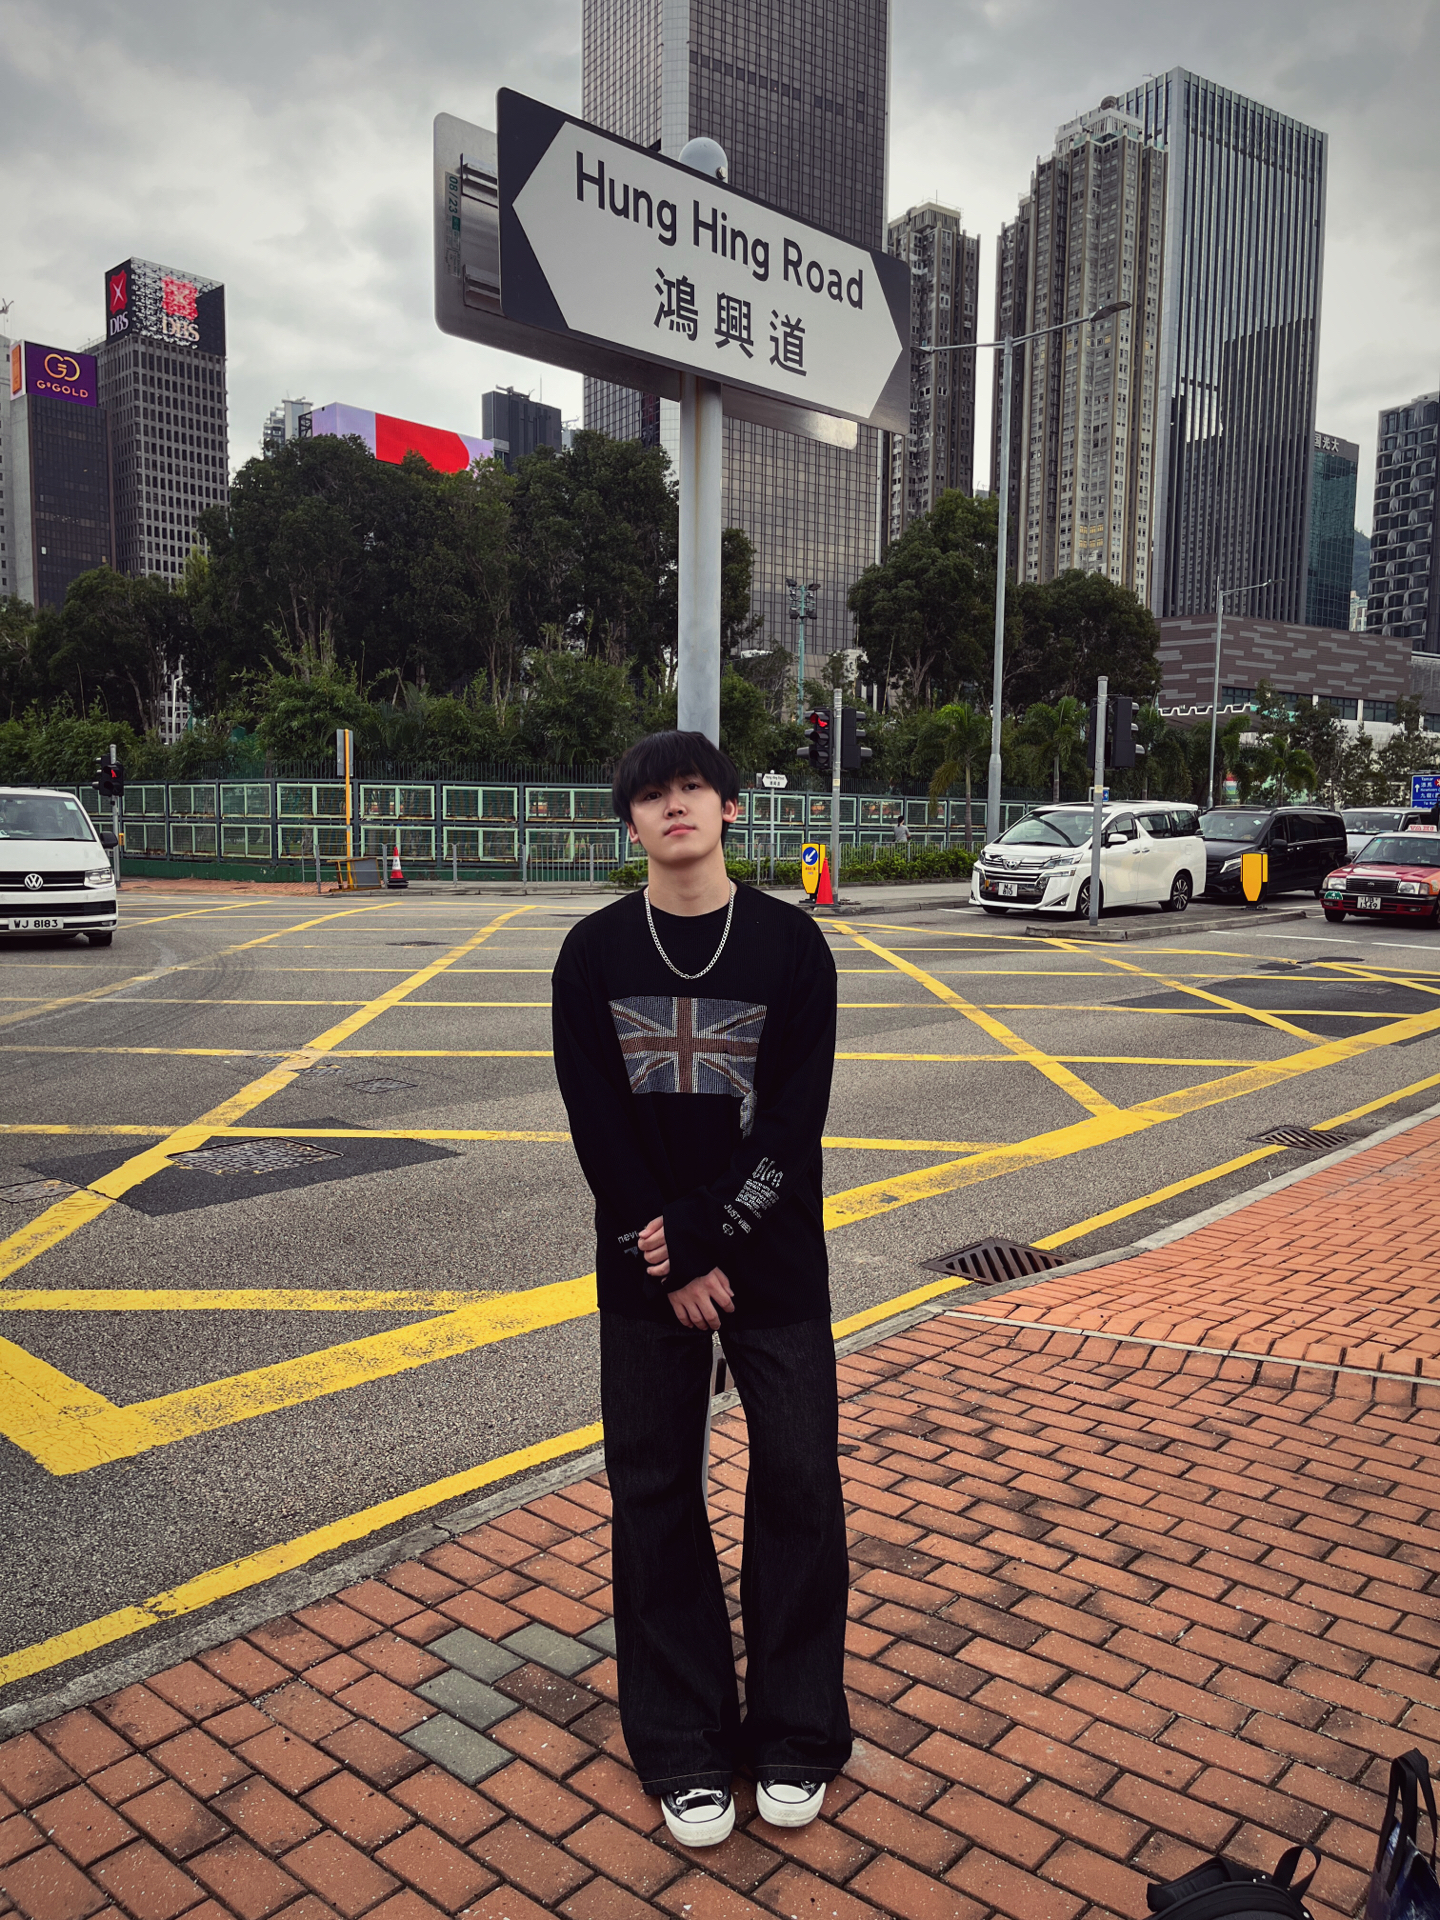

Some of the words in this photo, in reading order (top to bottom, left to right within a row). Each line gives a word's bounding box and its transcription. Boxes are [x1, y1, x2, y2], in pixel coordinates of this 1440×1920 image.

[576, 150, 677, 247] Hung
[692, 199, 770, 282] Hing
[783, 237, 864, 311] Road
[109, 311, 129, 337] DBS
[162, 317, 200, 342] DBS
[653, 267, 807, 377] 鴻興道
[14, 919, 29, 929] WJ
[33, 919, 58, 928] 8183
[723, 1204, 741, 1220] JUST
